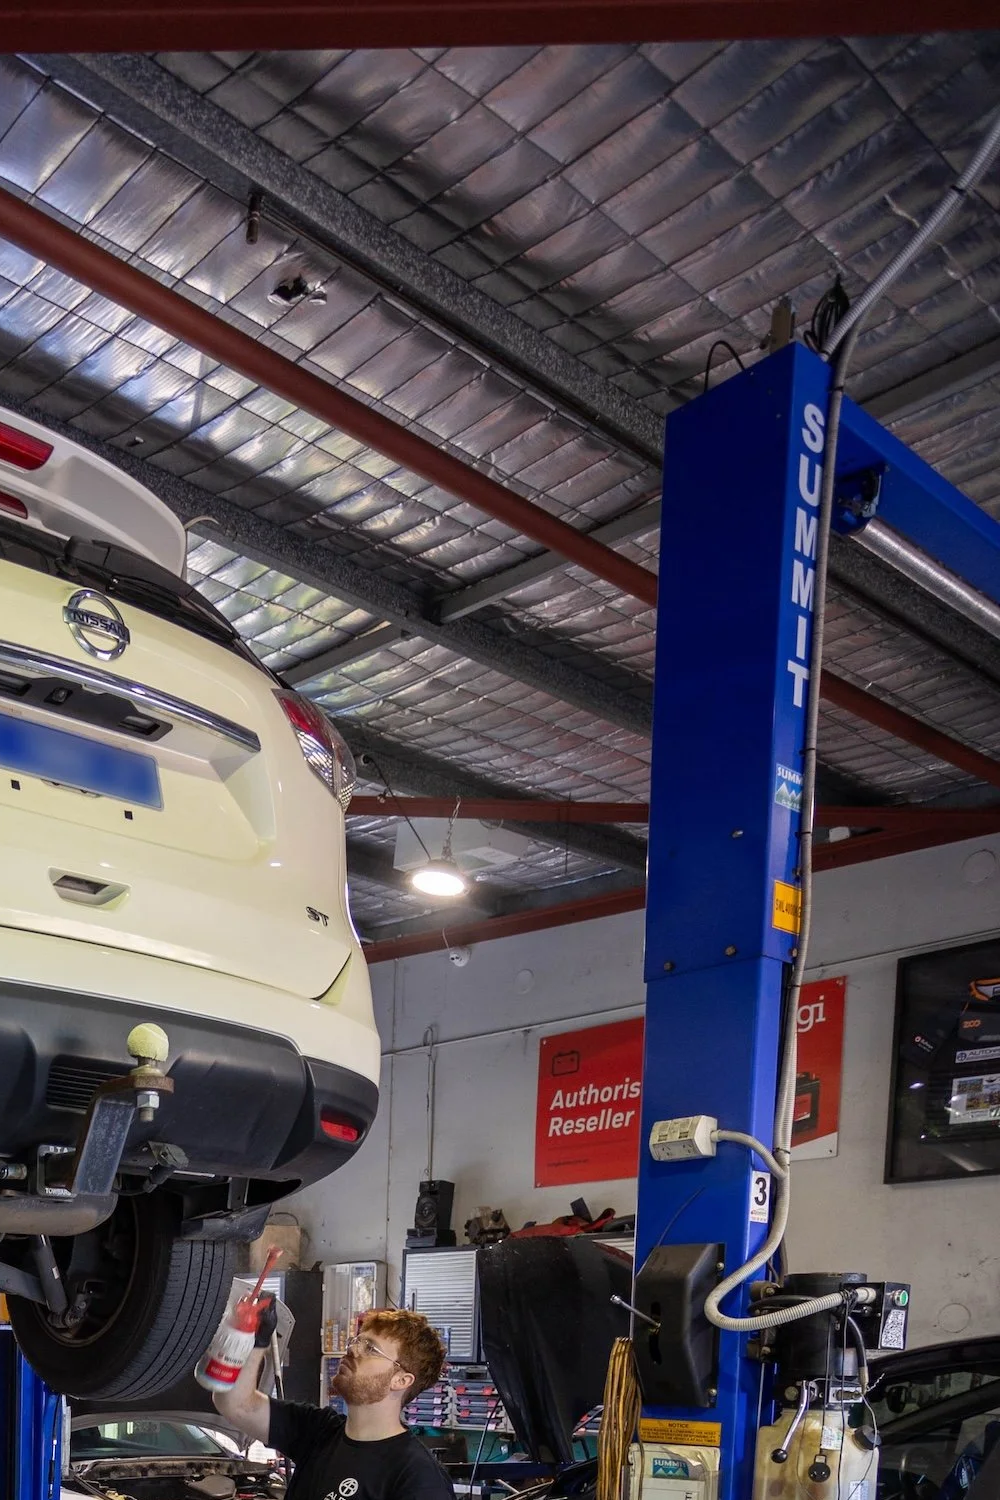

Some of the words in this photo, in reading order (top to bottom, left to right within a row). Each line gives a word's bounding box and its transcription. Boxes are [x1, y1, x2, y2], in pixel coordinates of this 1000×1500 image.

[788, 403, 826, 708] SUMMIT
[72, 609, 126, 640] NISSAN
[306, 906, 330, 927] ST
[549, 1077, 642, 1111] Authoris
[547, 1108, 635, 1137] Reseller
[754, 1176, 767, 1206] 3
[654, 1459, 687, 1468] SUMMIT
